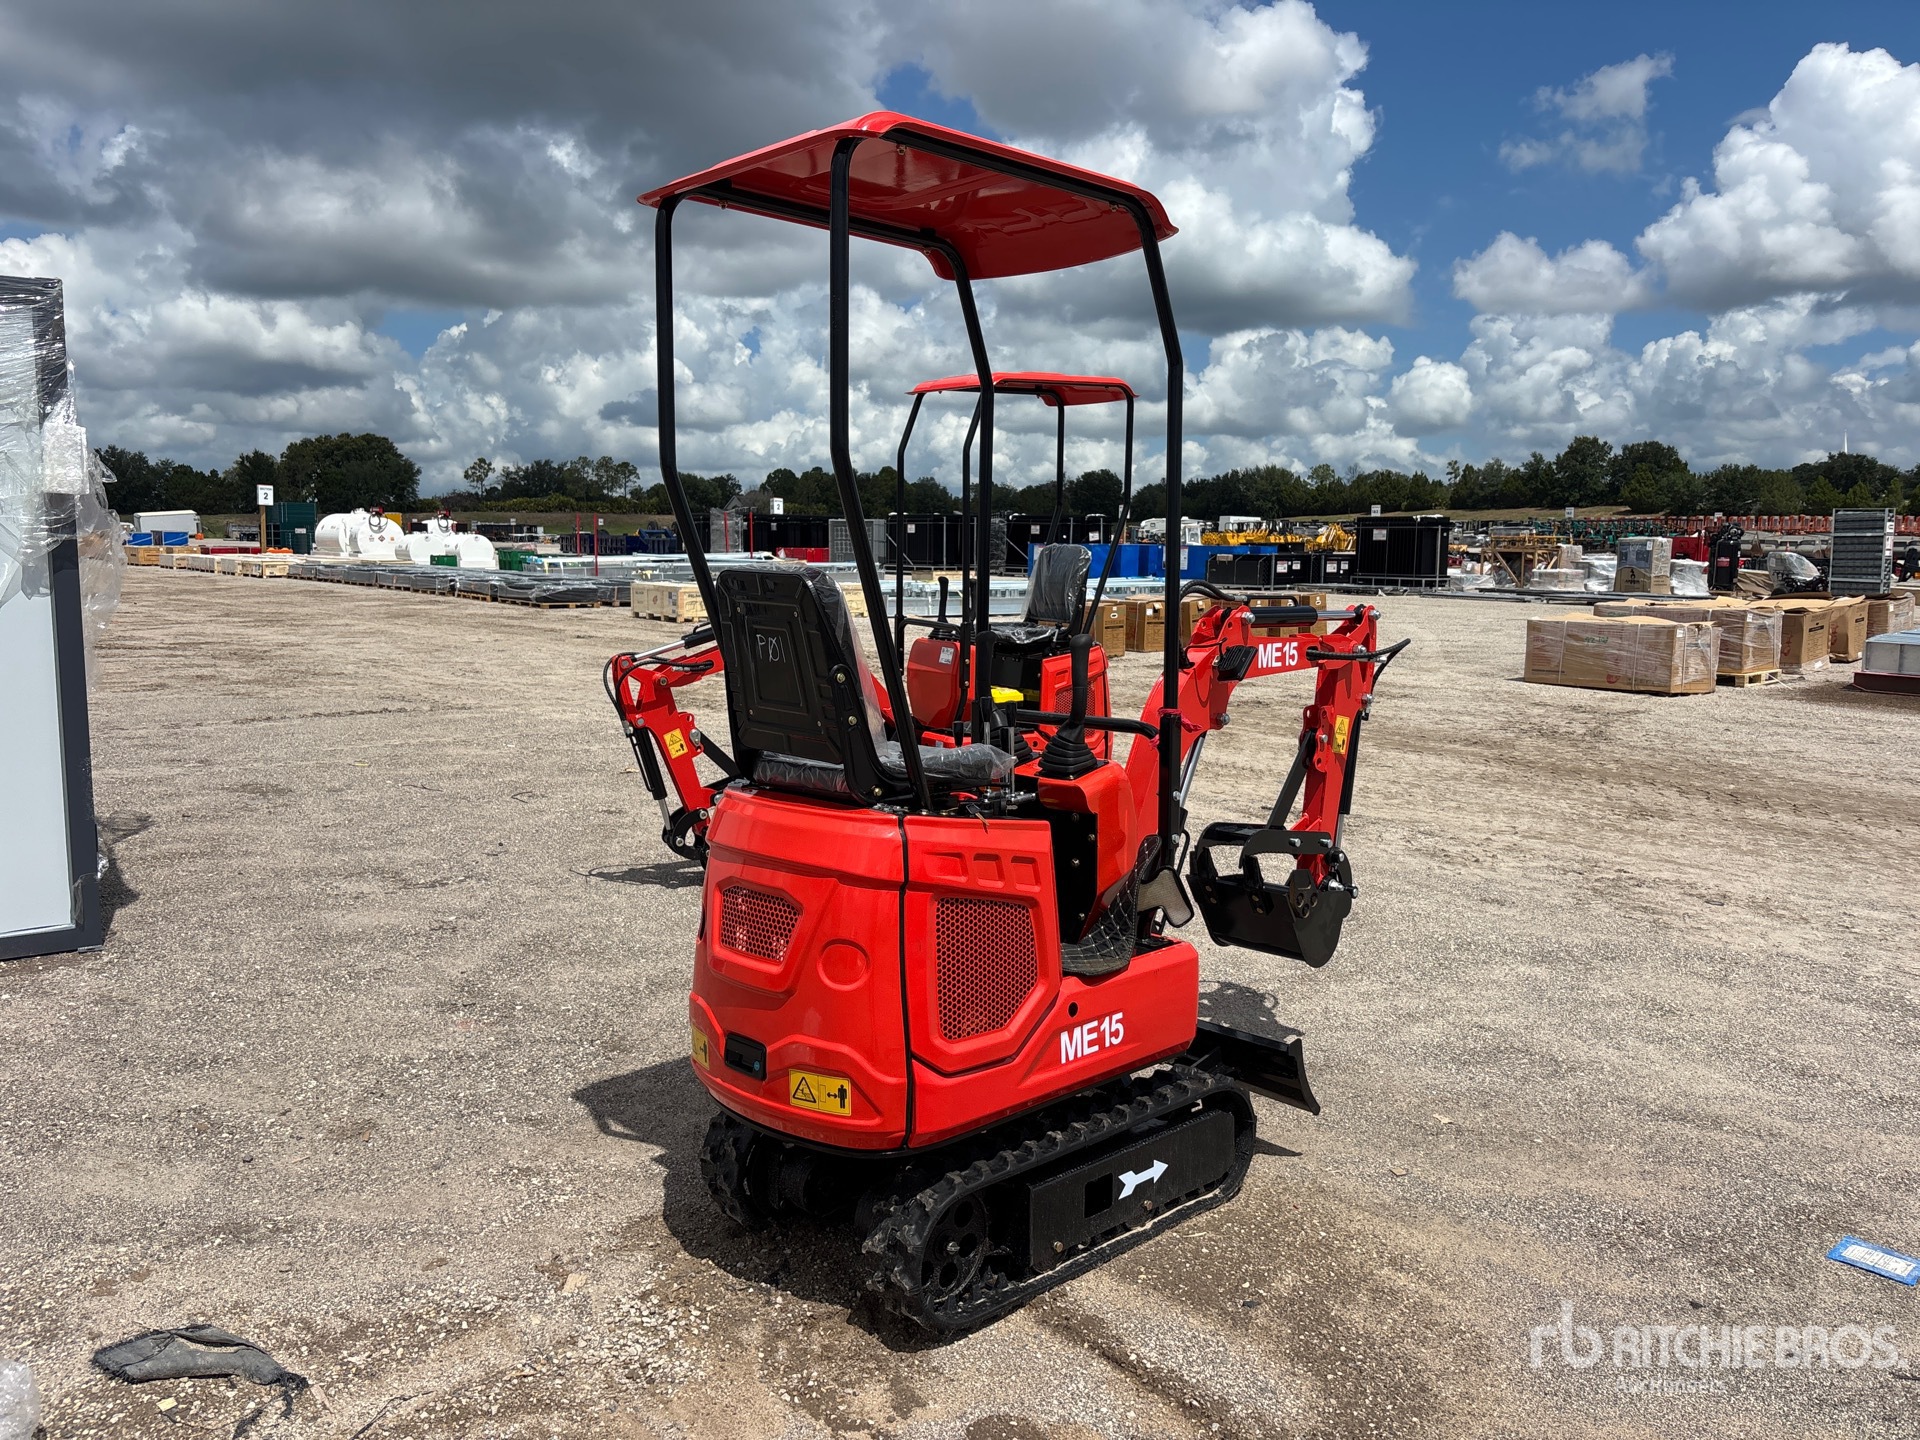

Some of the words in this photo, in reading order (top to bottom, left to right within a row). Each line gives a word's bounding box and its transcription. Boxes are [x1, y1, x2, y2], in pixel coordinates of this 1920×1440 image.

[263, 492, 269, 500] 2
[1258, 641, 1299, 669] ME15
[1060, 1011, 1125, 1065] ME15
